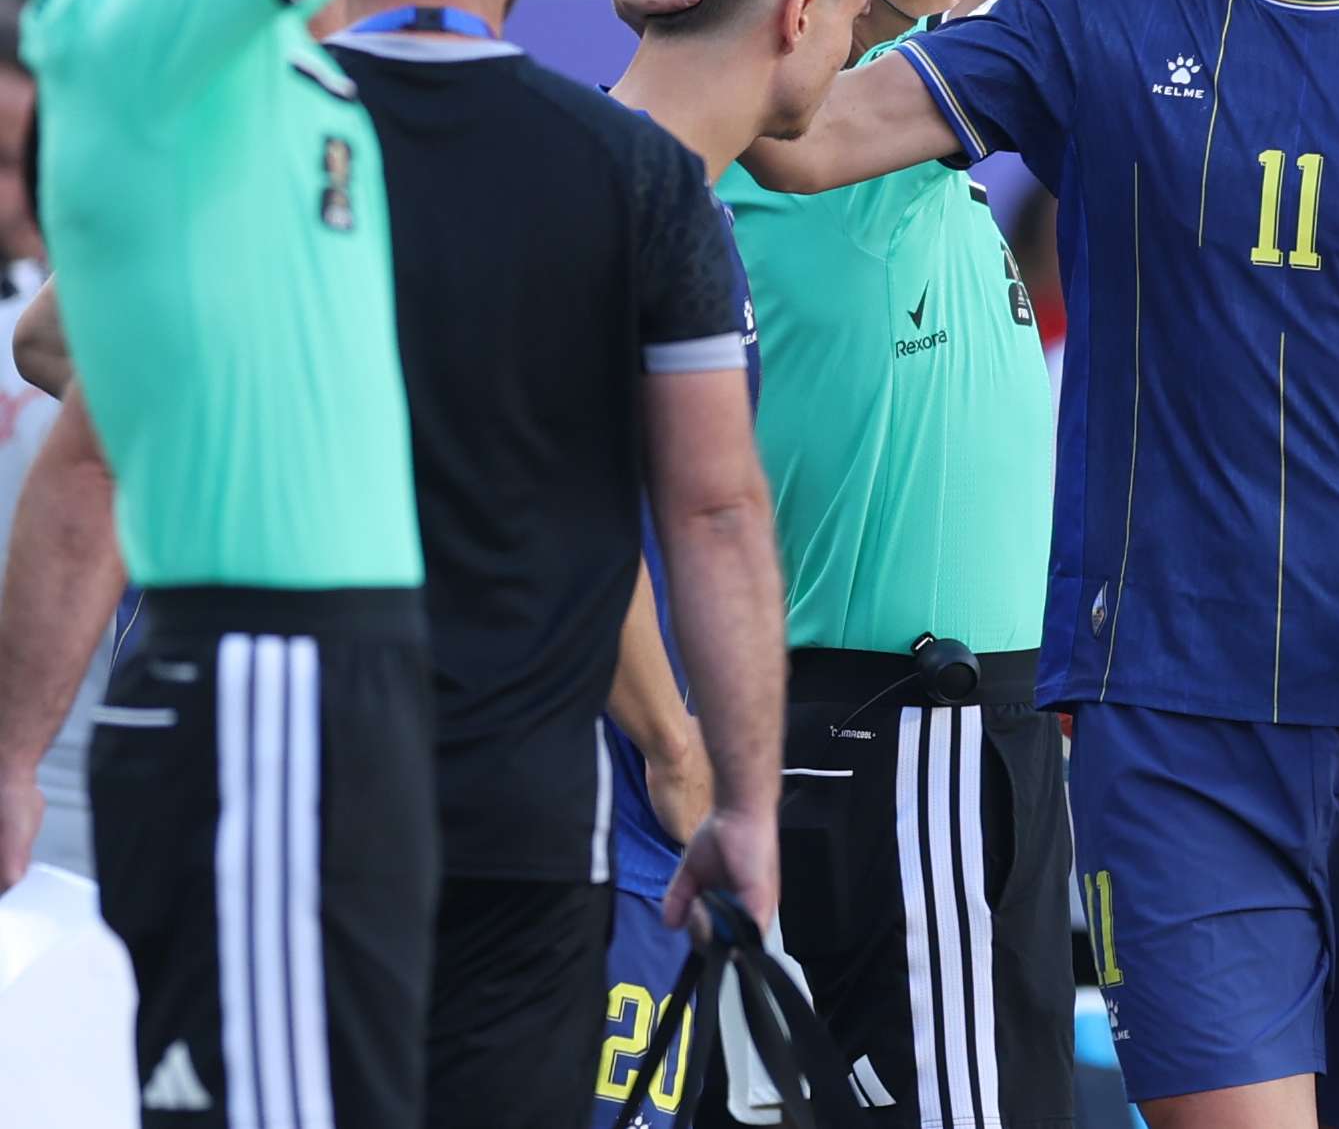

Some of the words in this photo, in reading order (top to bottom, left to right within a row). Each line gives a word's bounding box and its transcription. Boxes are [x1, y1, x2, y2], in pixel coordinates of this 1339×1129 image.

[1152, 84, 1205, 99] KELME
[1251, 150, 1324, 271] 11
[594, 981, 693, 1115] 20
